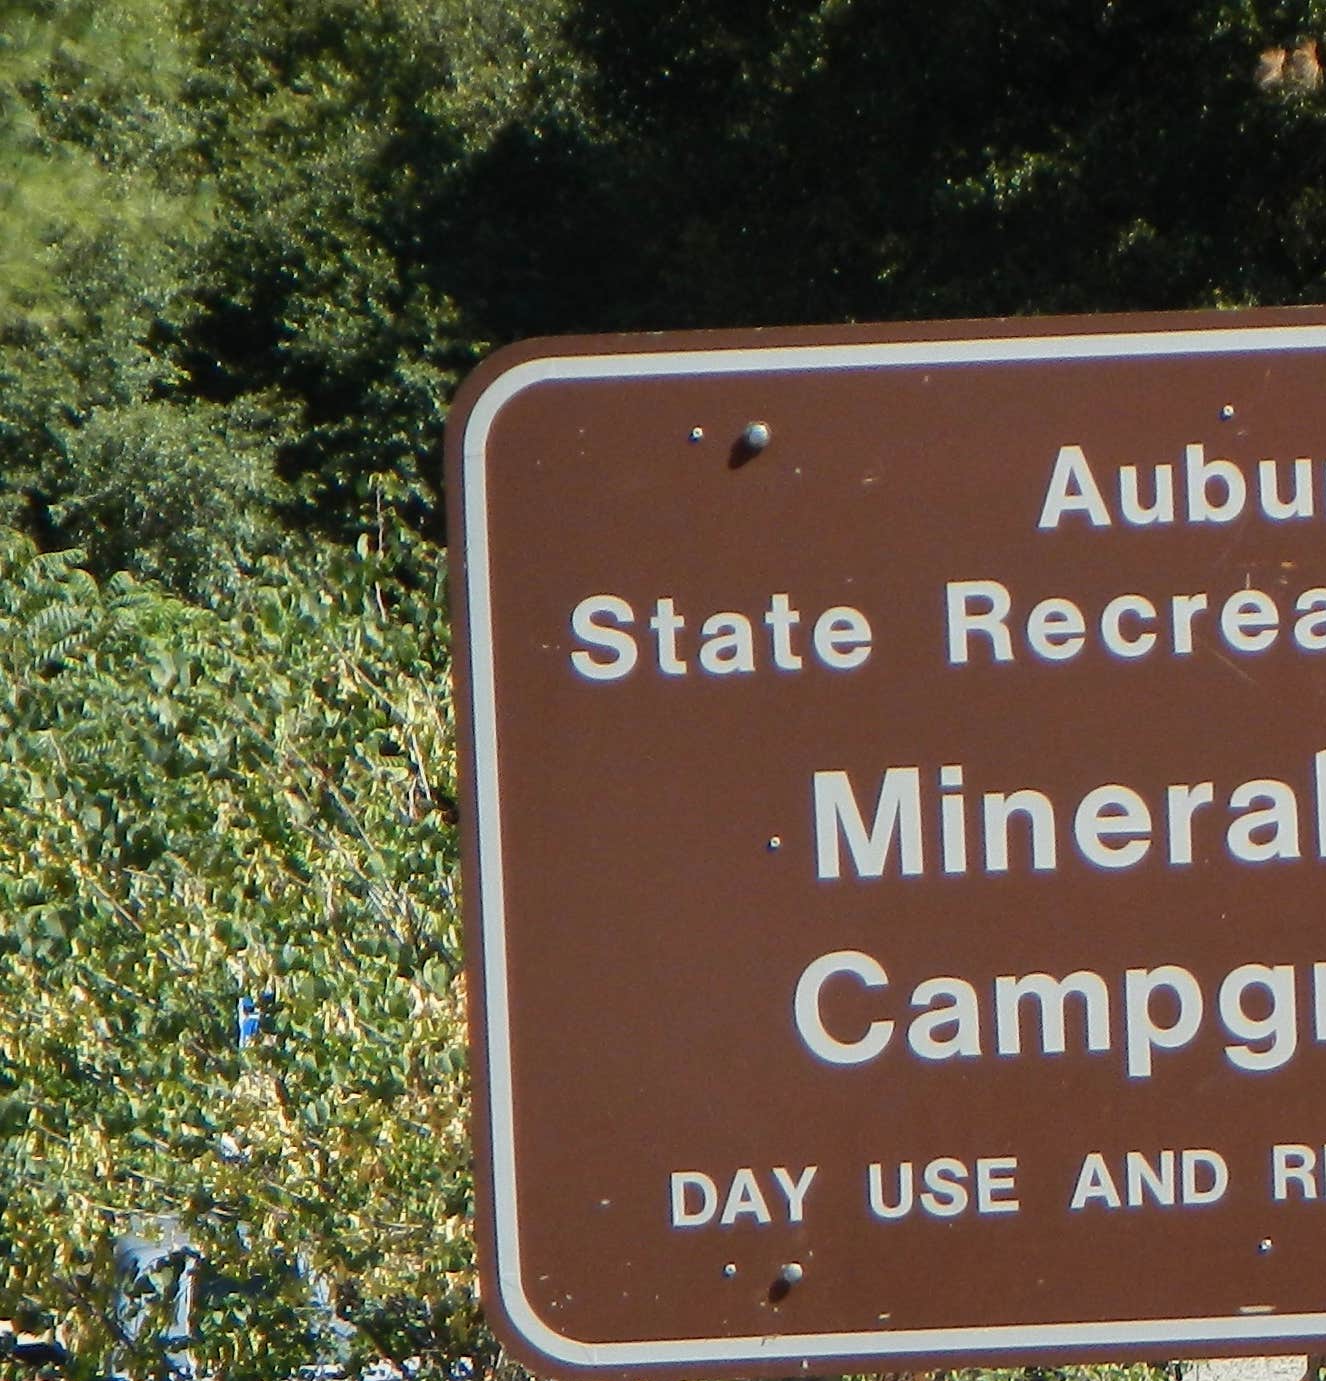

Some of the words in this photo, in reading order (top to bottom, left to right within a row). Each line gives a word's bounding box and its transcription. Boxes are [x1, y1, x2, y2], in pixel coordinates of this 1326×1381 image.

[570, 594, 873, 683] State
[670, 1165, 818, 1227] DAY
[868, 1157, 1020, 1219] USE
[1069, 1149, 1229, 1210] AND
